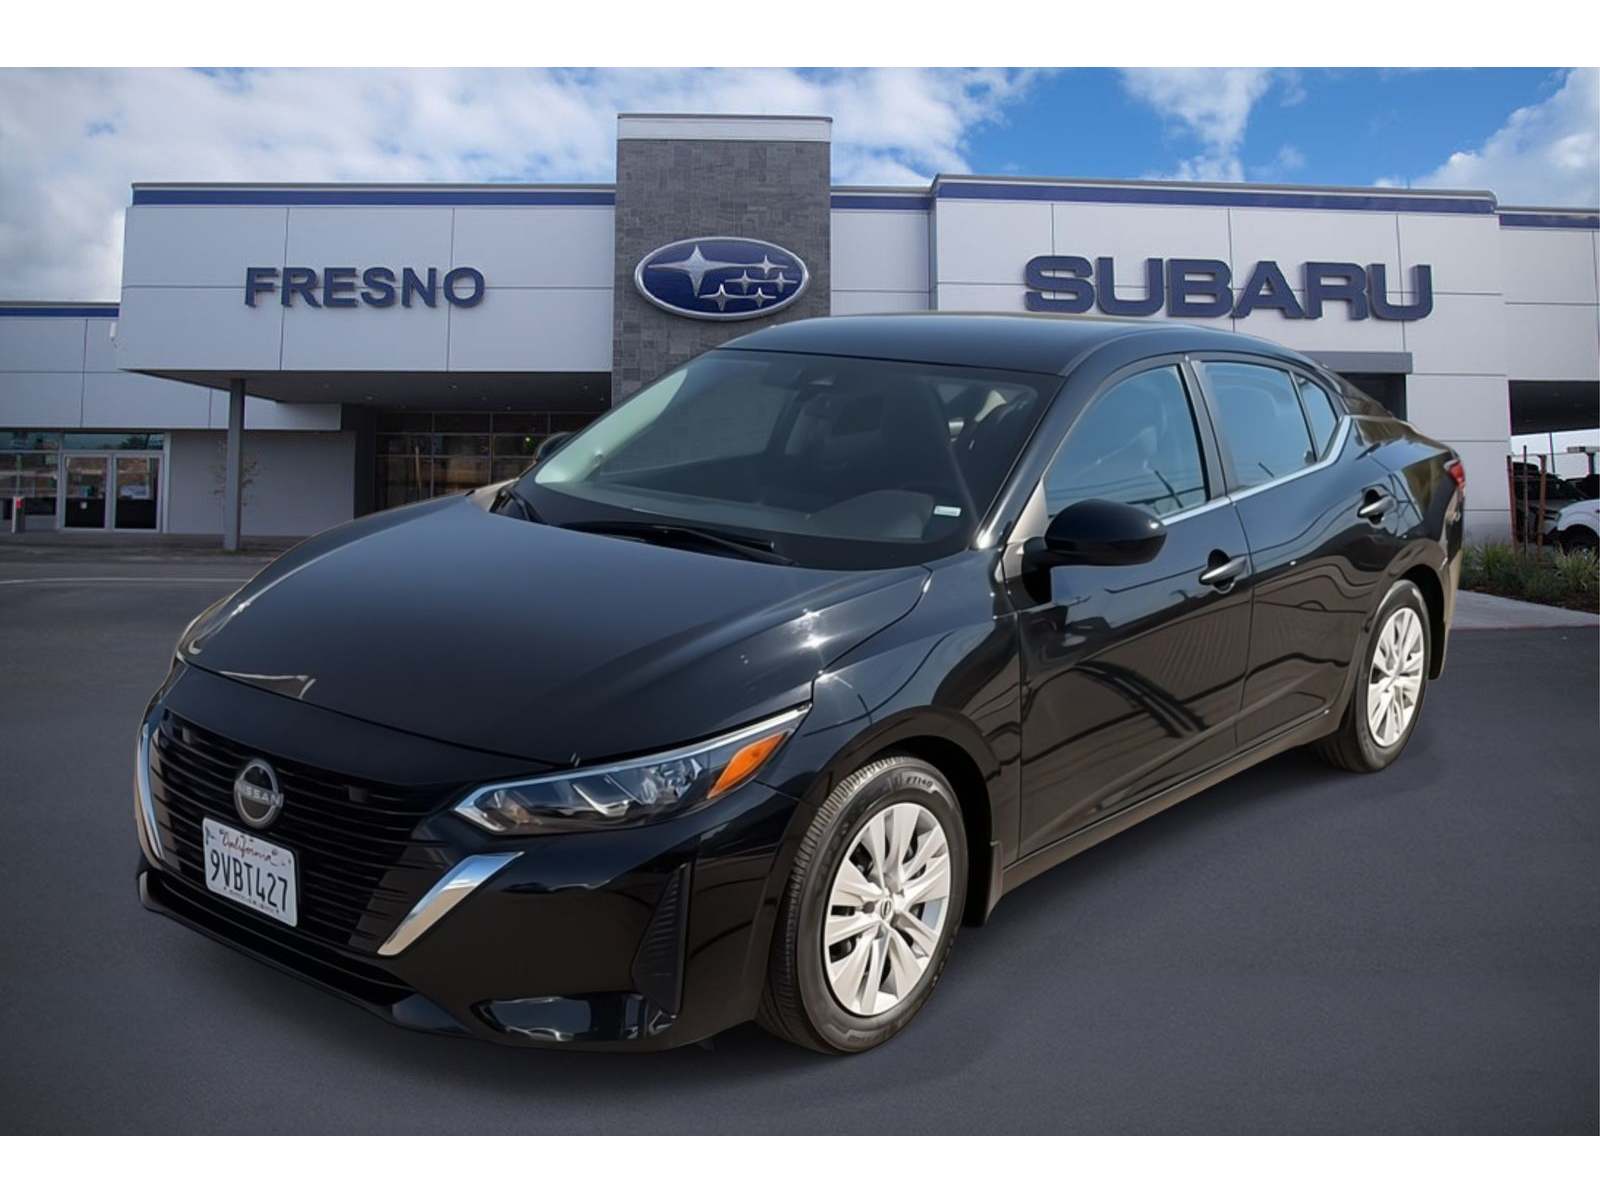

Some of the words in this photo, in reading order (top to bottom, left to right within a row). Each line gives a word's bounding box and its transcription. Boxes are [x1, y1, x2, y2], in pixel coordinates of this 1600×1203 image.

[244, 267, 485, 308] FRESNO
[1024, 255, 1433, 320] SUBARU
[223, 832, 277, 866] California
[211, 849, 287, 912] 9VBT427
